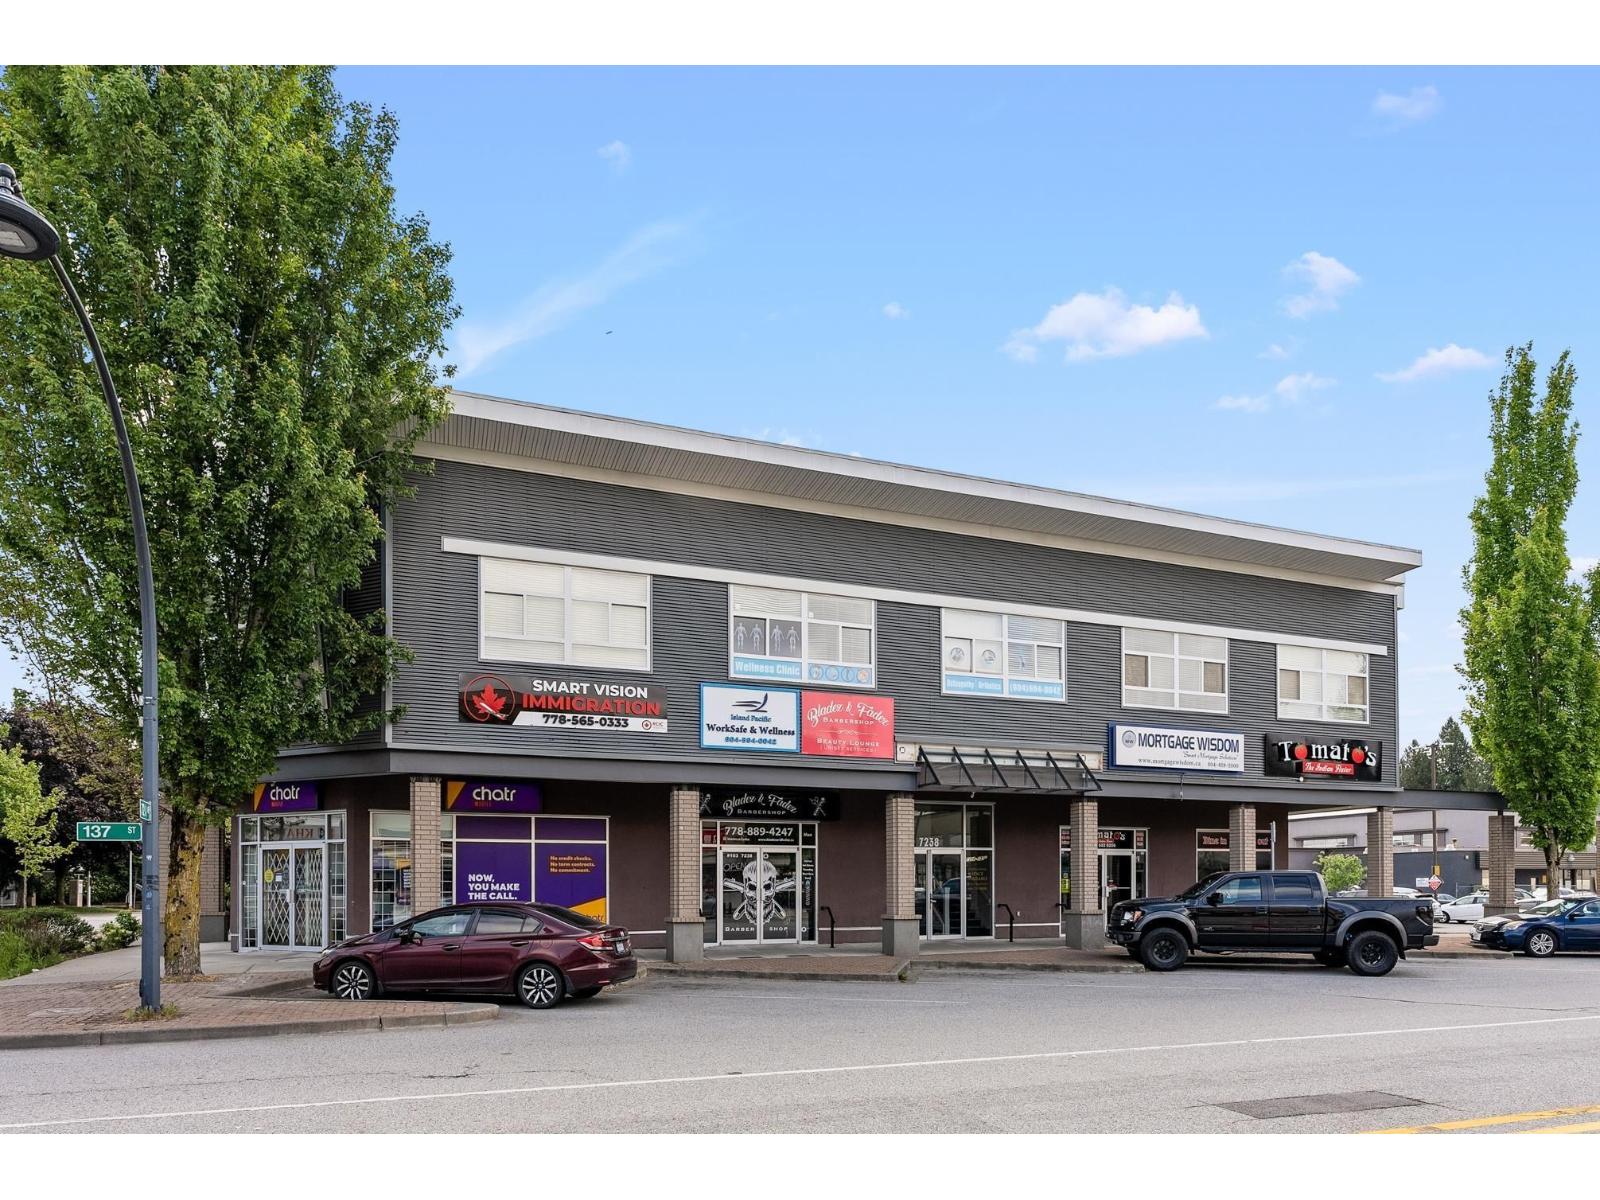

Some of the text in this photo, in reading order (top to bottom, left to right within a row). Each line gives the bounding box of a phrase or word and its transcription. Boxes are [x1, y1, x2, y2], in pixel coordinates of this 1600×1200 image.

[735, 661, 800, 675] Wellness Clinic
[532, 679, 648, 699] SMART VISION
[522, 693, 661, 717] IMMIGRATION
[542, 713, 630, 728] 778-565-0333
[730, 713, 772, 723] Island Pacific
[823, 717, 874, 726] BARBERSHOP
[706, 723, 796, 736] WorkSafe & Wellness
[1138, 733, 1240, 753] MORTGAGE WISDOM
[1305, 762, 1315, 771] The
[1315, 762, 1333, 772] Indian
[270, 785, 300, 801] chatr
[472, 785, 517, 801] chatr
[82, 825, 136, 838] 137 ST
[725, 826, 794, 837] 778-889-4247
[468, 874, 495, 883] NOW,
[468, 883, 520, 891] YOU MAKE
[468, 892, 517, 900] THE CALL.
